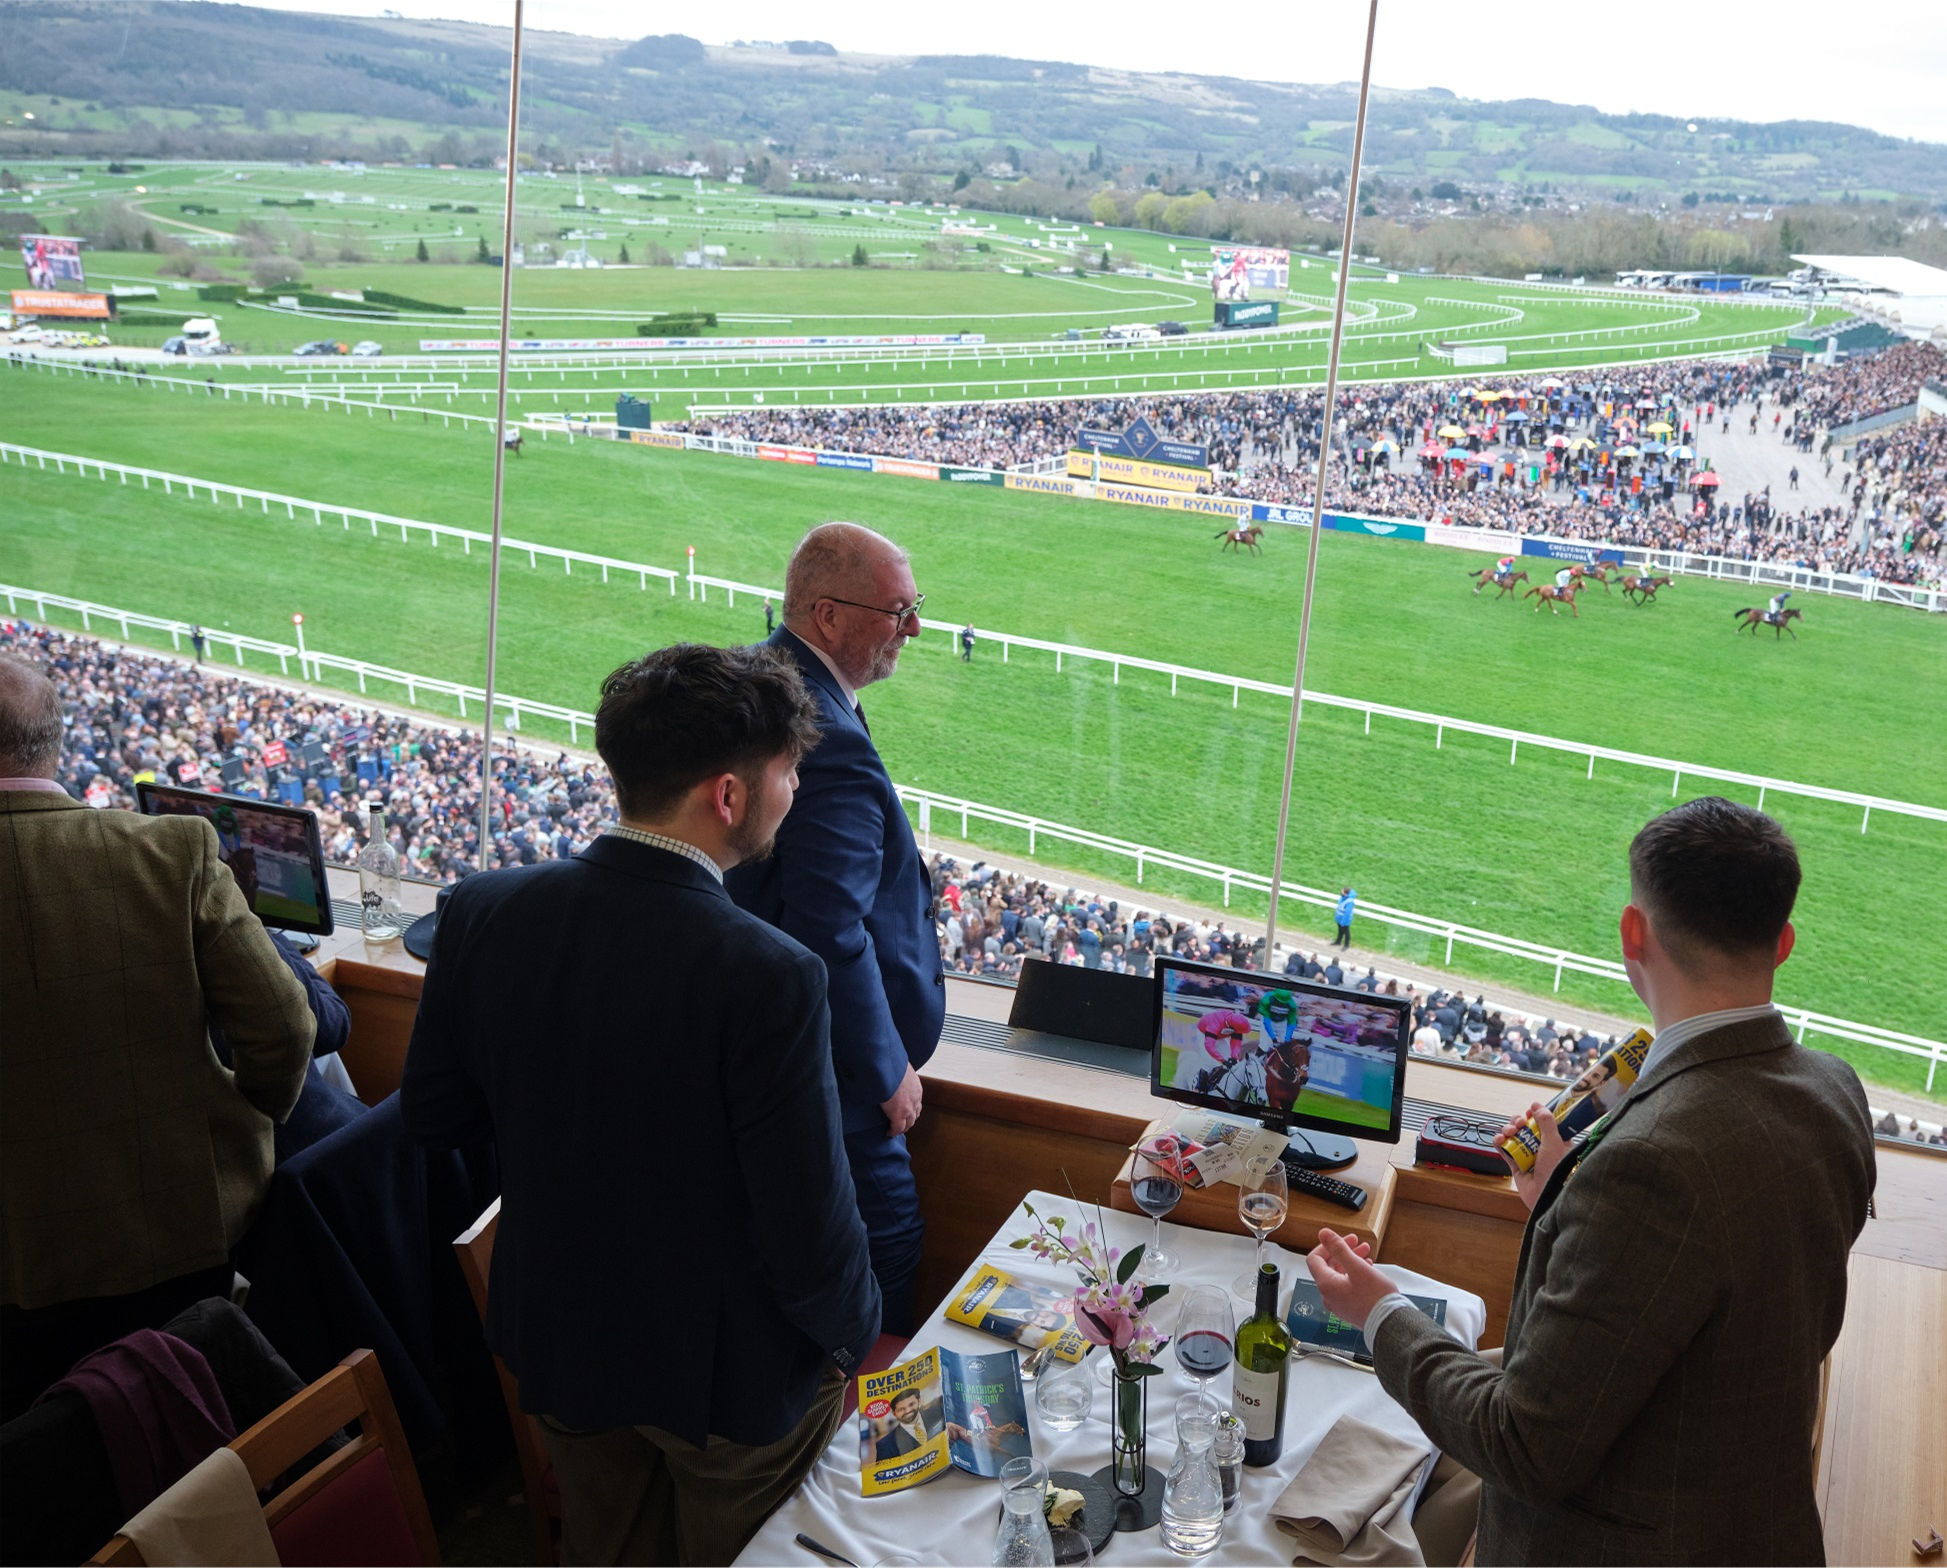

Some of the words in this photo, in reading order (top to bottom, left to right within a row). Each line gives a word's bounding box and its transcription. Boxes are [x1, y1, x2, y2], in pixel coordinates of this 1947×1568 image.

[638, 433, 681, 447] RYANAIR
[1015, 475, 1074, 494] RYANAIR
[1153, 468, 1207, 484] RYANAIR
[1107, 488, 1170, 507] RYANAIR
[1183, 498, 1250, 517] RYANAIR
[1285, 510, 1314, 525] GROU
[1548, 543, 1595, 554] CHELTENHA
[1555, 551, 1588, 562] FESTIVAL
[964, 1282, 995, 1314] RYANAIR
[866, 1370, 905, 1390] OVER
[907, 1355, 933, 1377] 250
[866, 1365, 934, 1398] DESTINATIONS
[966, 1383, 1004, 1394] PATRICK'S
[885, 1452, 936, 1478] RYANAIR
